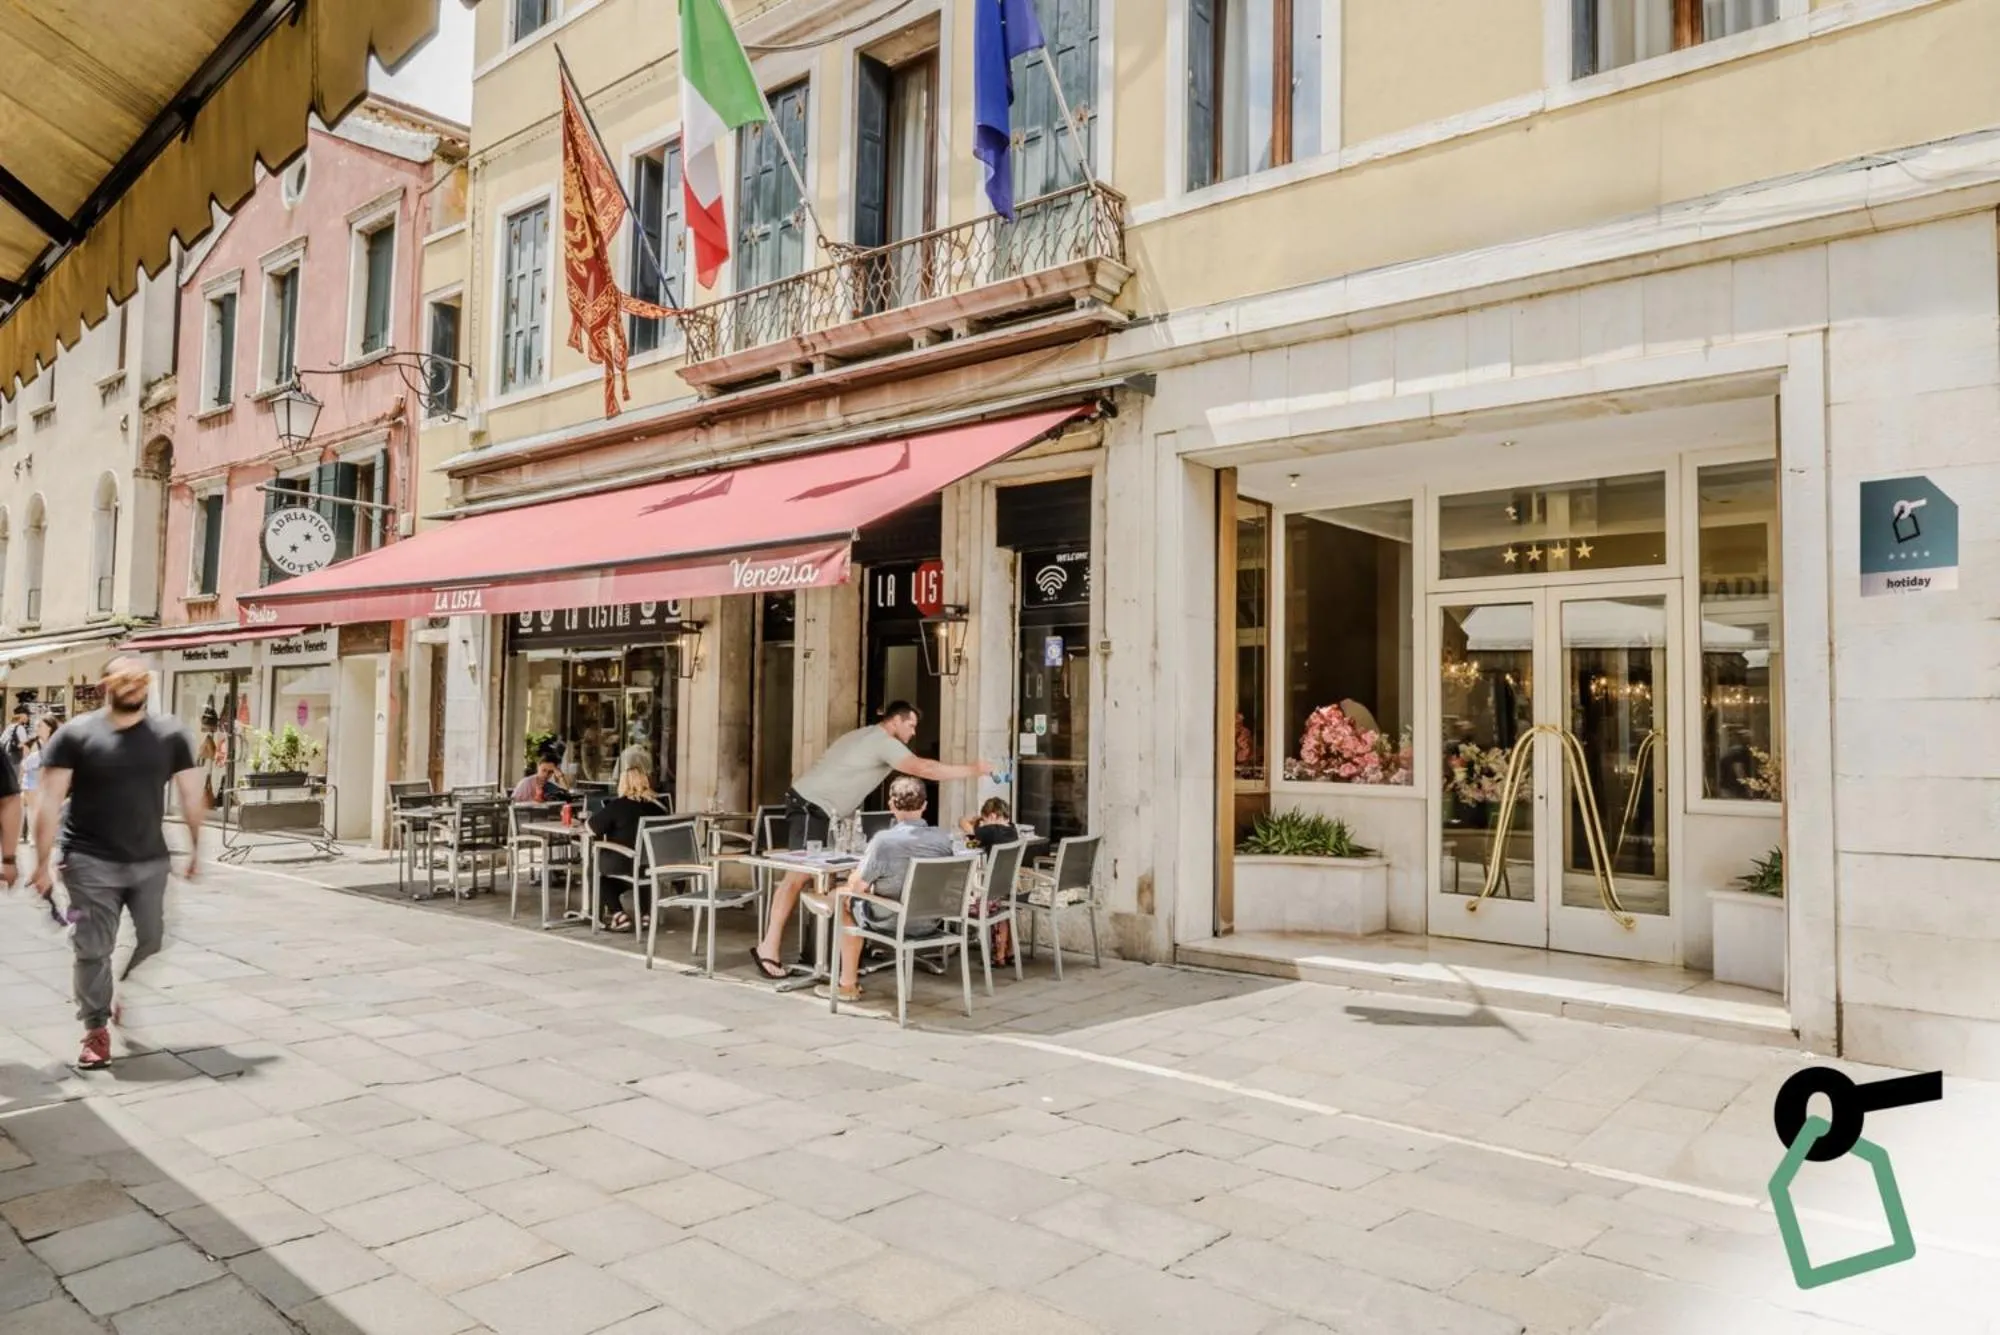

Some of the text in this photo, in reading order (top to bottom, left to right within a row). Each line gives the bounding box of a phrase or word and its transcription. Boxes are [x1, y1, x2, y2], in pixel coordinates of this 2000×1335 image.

[271, 511, 331, 543] ADRIATICO
[277, 555, 324, 573] HOTEL
[729, 557, 820, 590] Venezia
[877, 570, 944, 607] LA LIS
[1887, 576, 1931, 588] hotiday
[435, 590, 481, 610] LA LISTA
